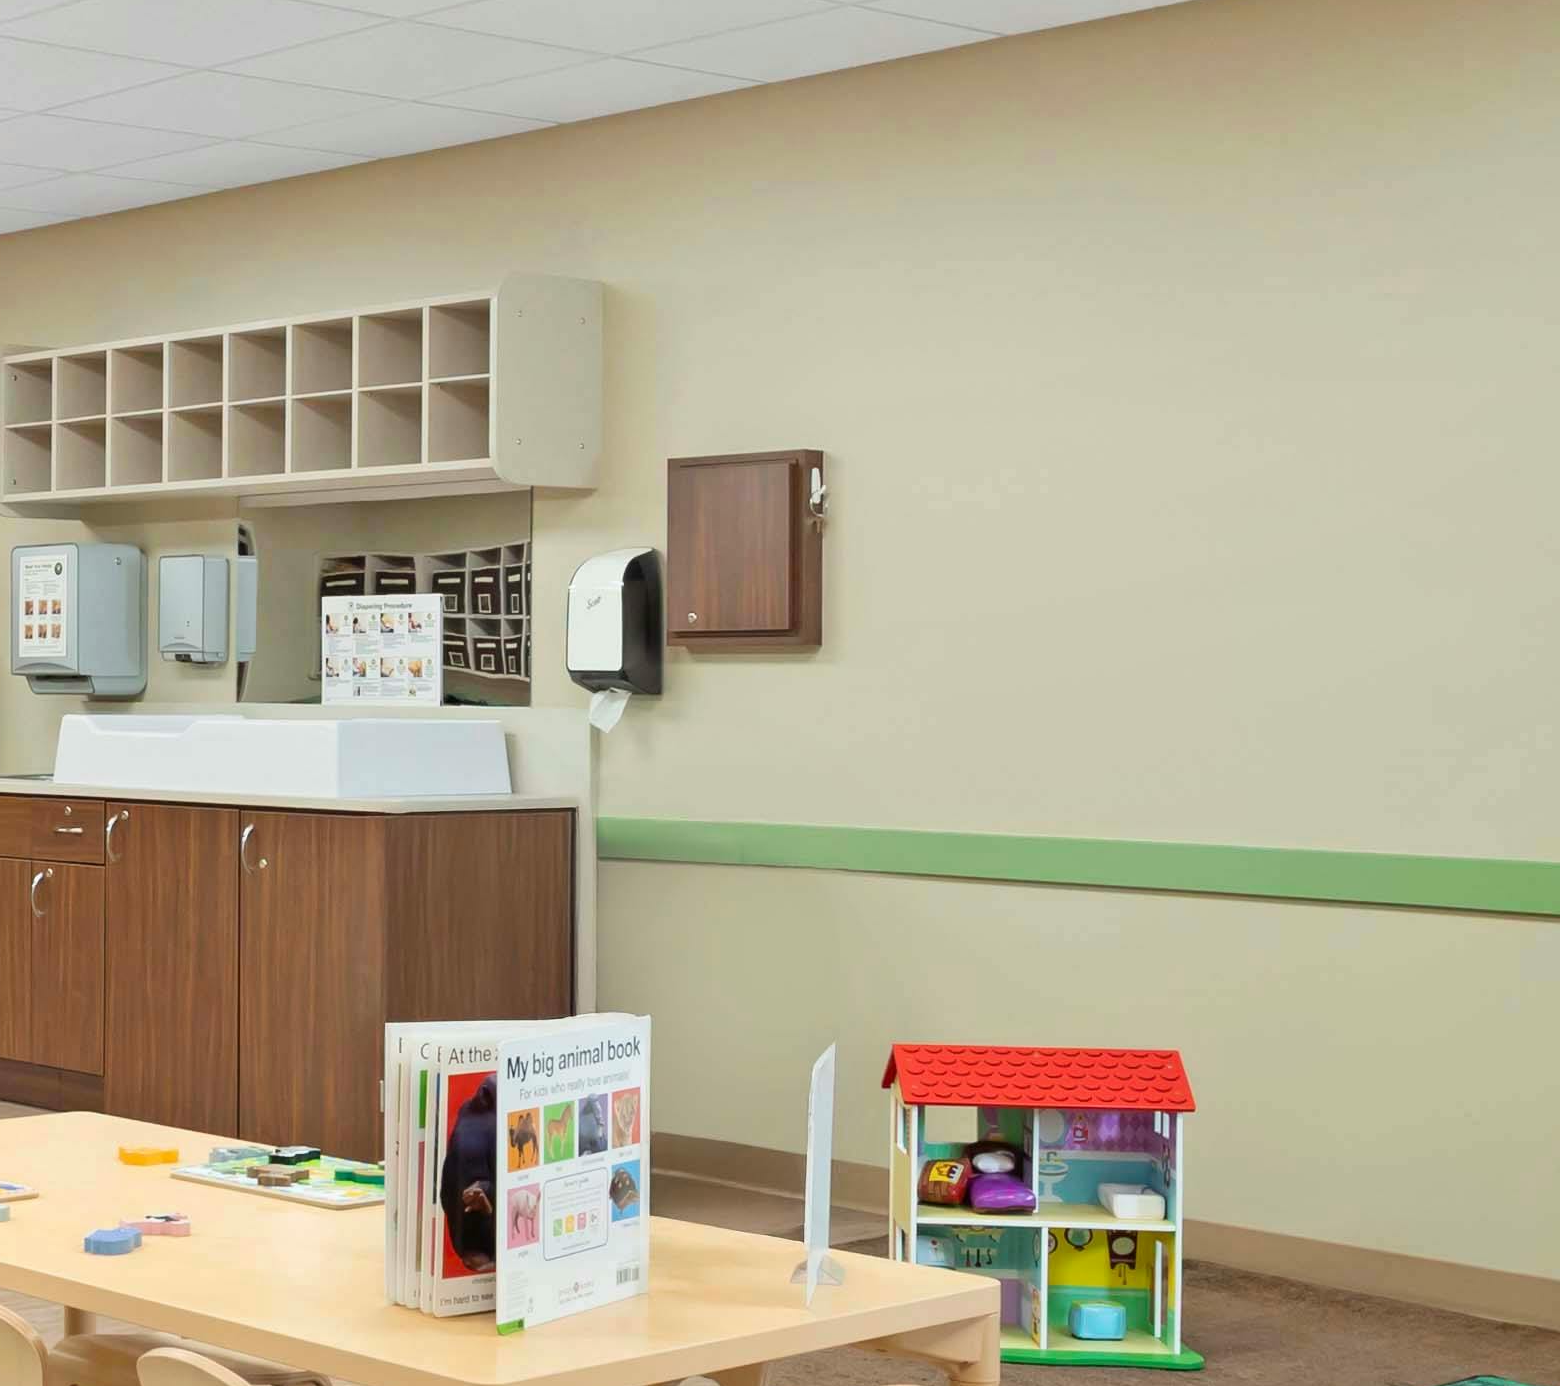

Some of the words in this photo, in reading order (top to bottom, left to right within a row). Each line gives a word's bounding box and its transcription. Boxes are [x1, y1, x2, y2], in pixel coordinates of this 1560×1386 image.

[448, 1048, 465, 1065] At
[468, 1046, 491, 1063] the
[507, 1056, 528, 1082] My
[532, 1052, 554, 1077] big
[558, 1041, 604, 1070] animal
[607, 1036, 641, 1058] book
